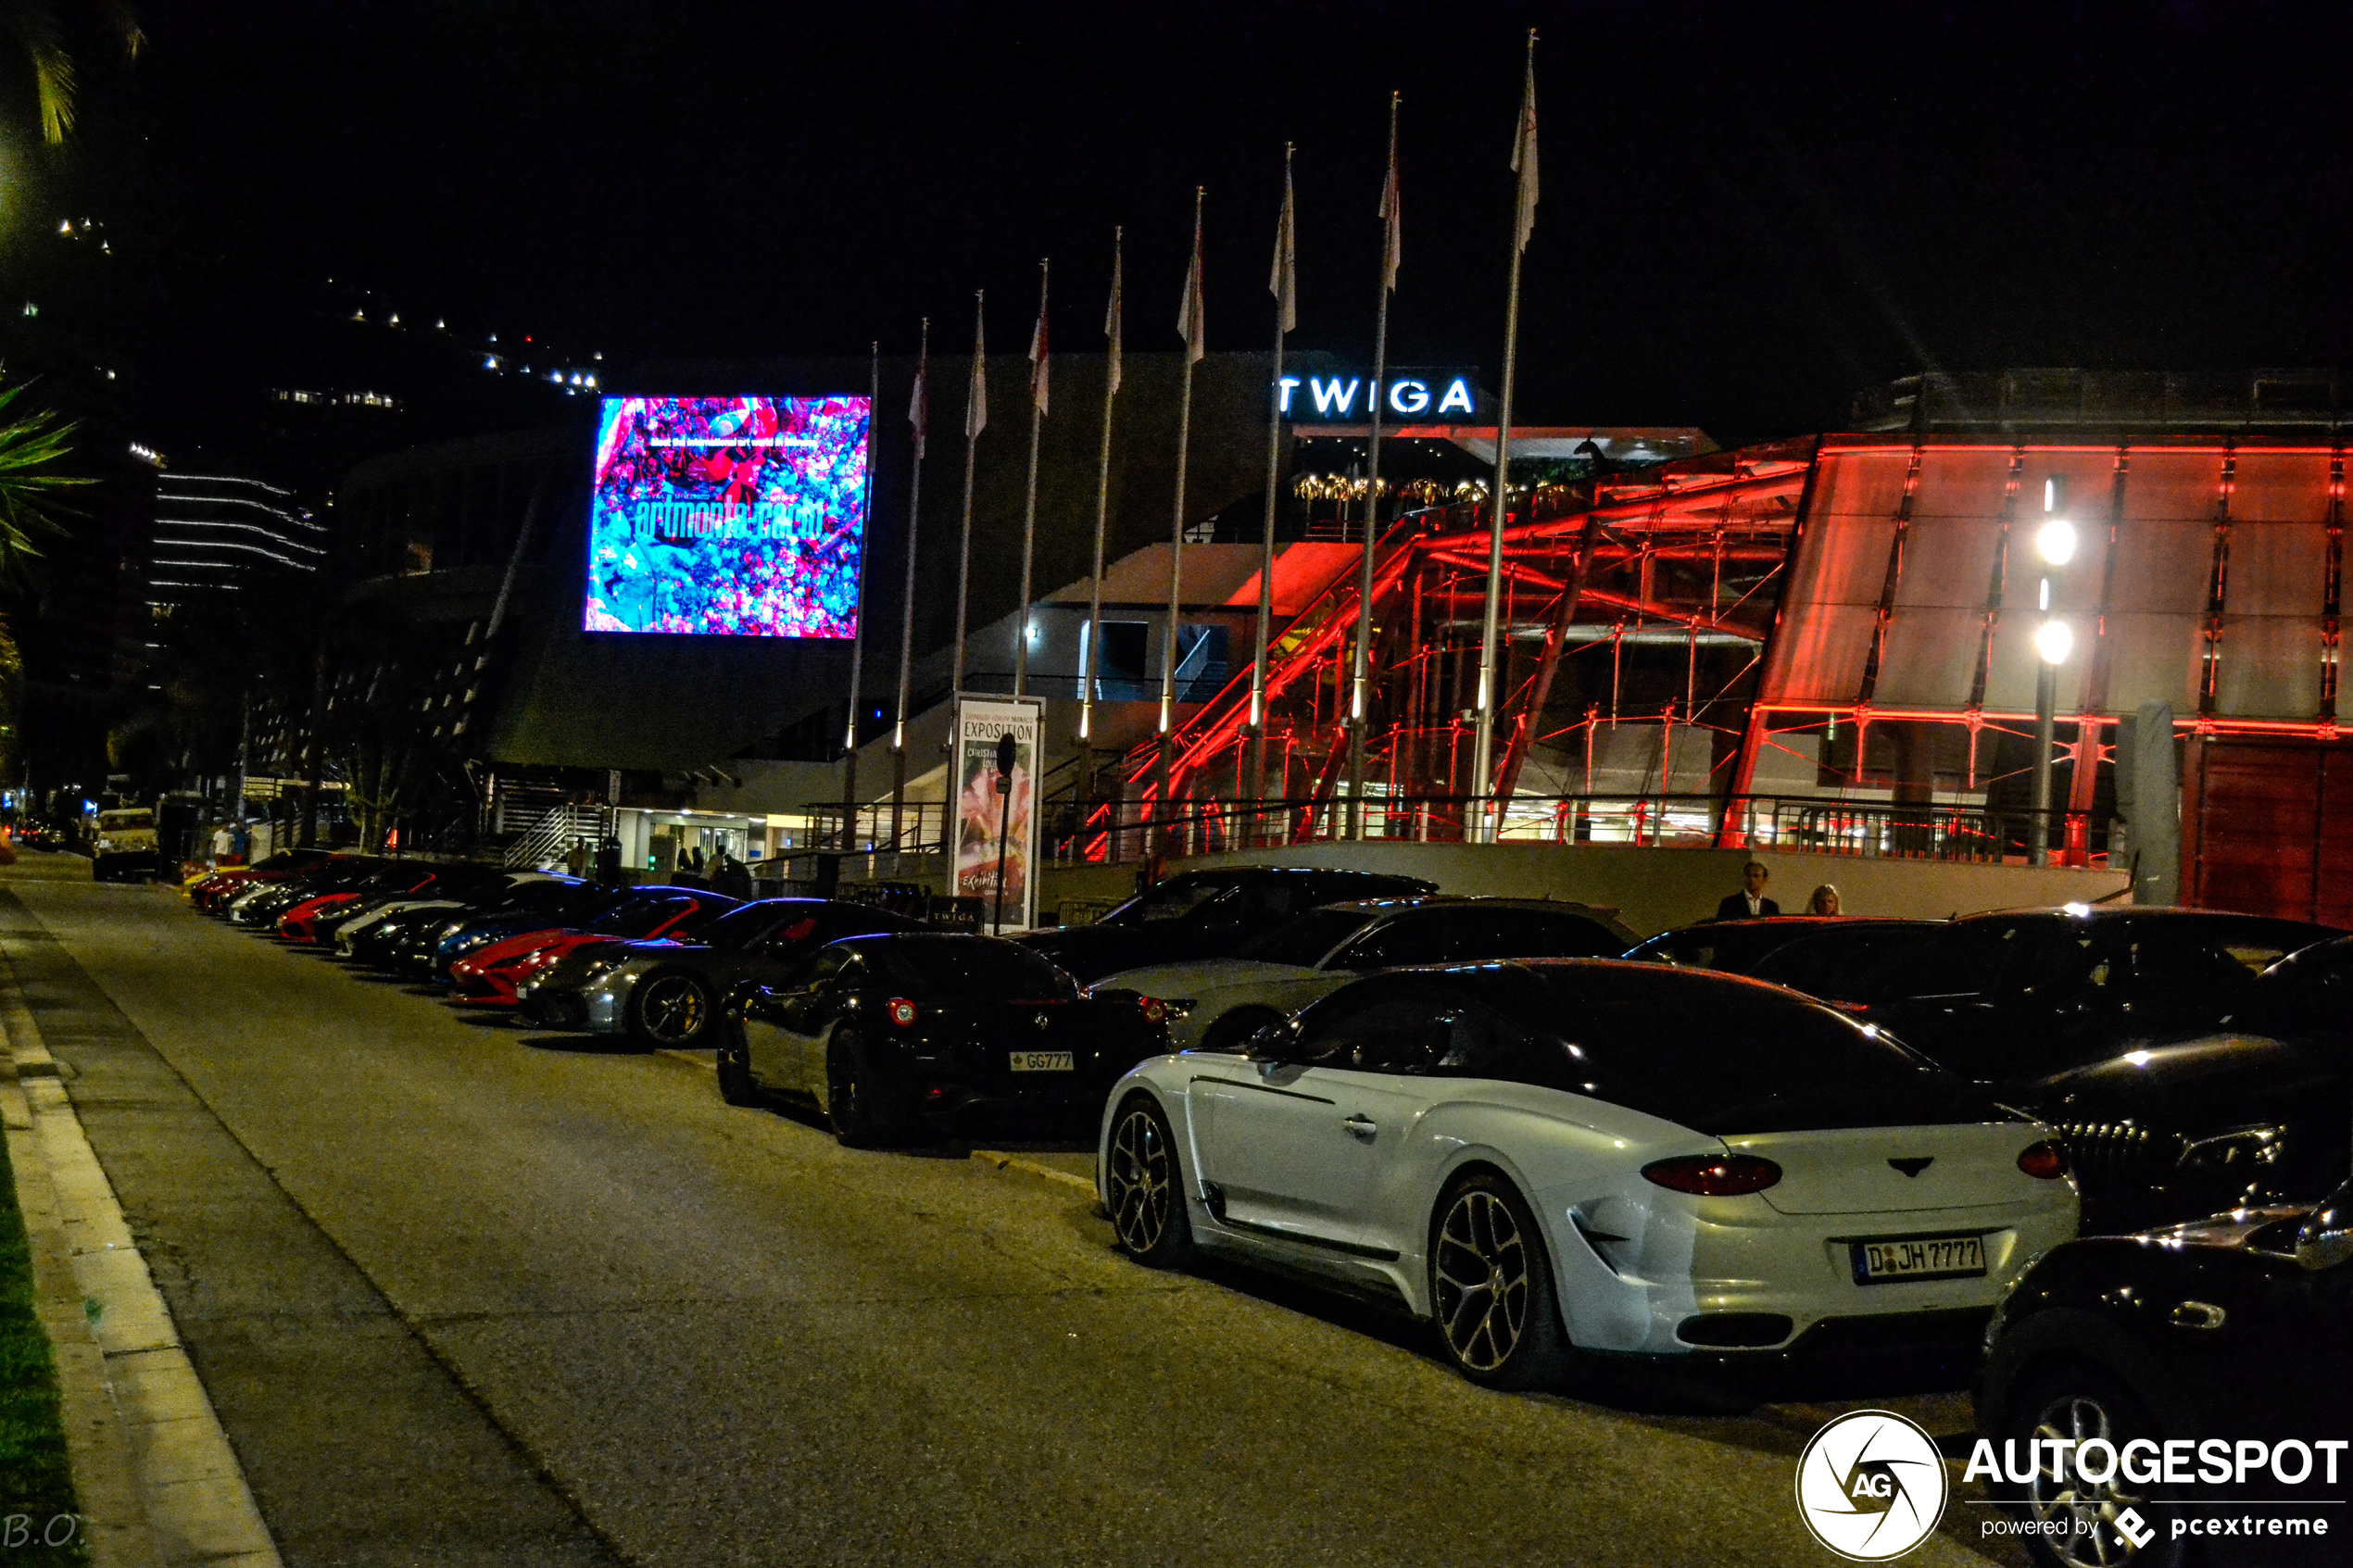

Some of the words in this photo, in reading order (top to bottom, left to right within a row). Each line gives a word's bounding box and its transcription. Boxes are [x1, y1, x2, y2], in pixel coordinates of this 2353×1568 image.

[1273, 378, 1473, 414] TWIGA
[687, 438, 737, 447] international
[964, 721, 1033, 740] EXPOSITION
[967, 747, 997, 759] CHRISTIA
[934, 912, 975, 922] TWIGA
[1026, 1053, 1071, 1068] GG777
[1928, 1240, 1978, 1268] 7777
